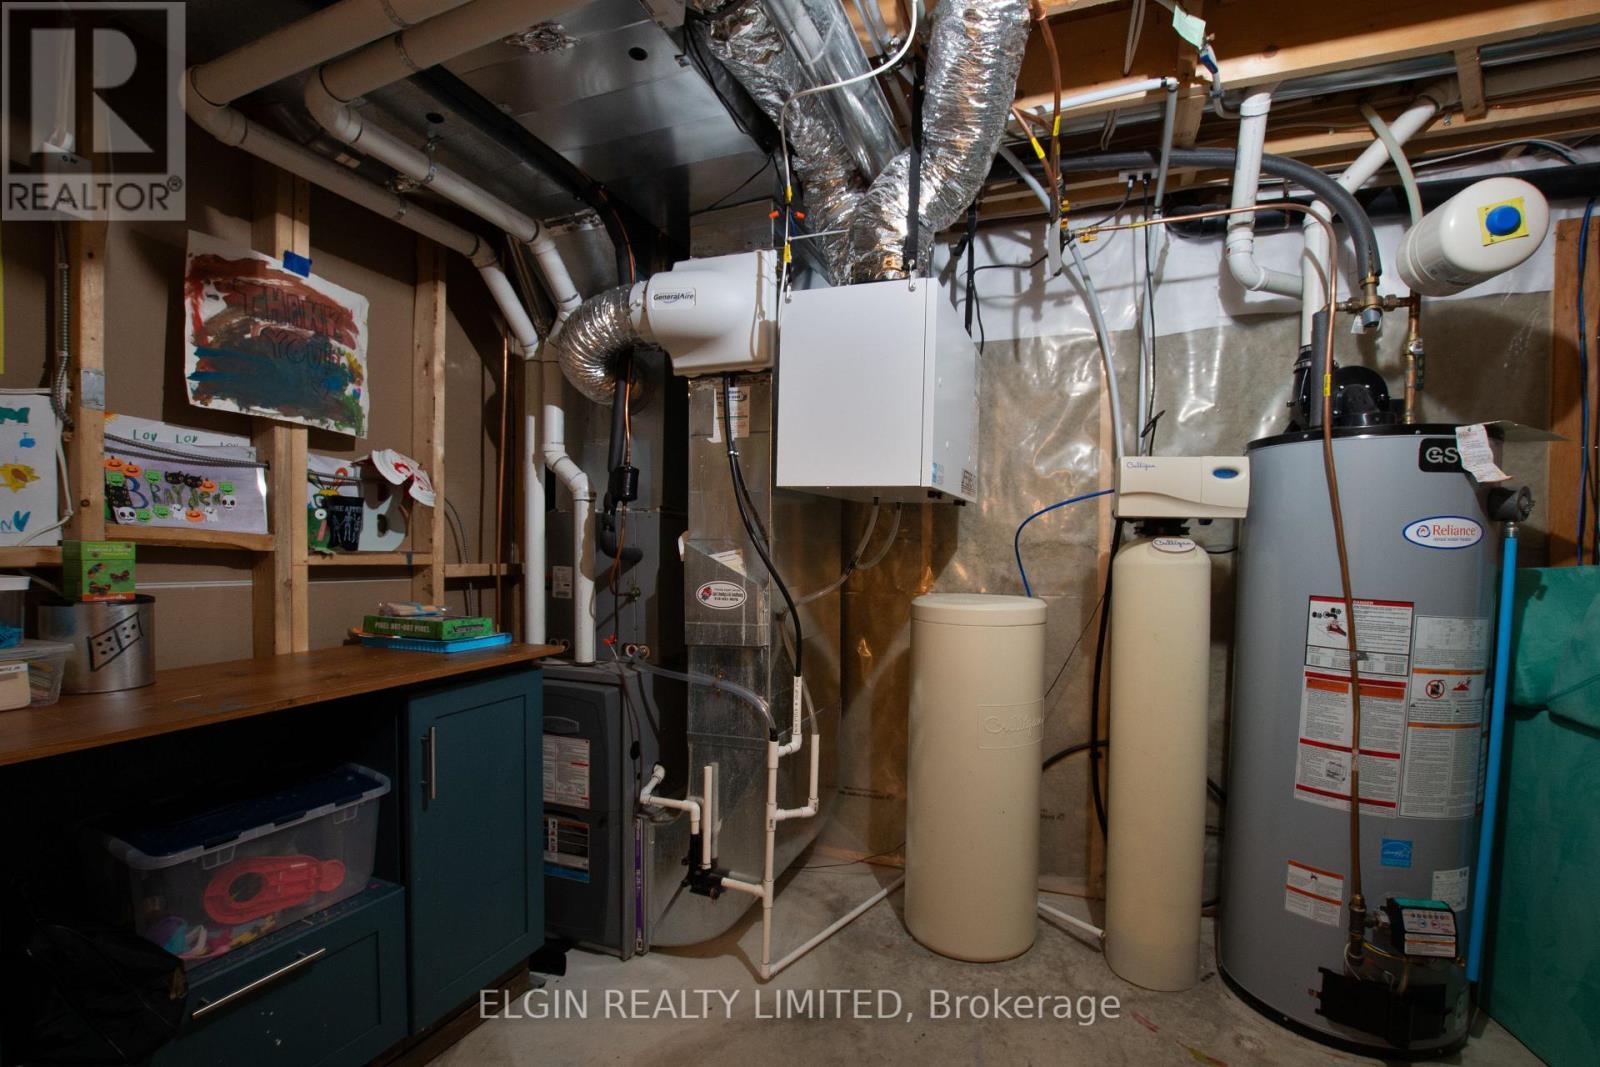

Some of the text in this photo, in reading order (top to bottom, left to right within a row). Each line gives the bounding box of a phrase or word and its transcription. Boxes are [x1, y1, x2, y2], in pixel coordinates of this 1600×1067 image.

[653, 292, 695, 301] GeneralAire
[1126, 462, 1156, 471] Culligan
[1432, 524, 1476, 536] Reliance
[1153, 539, 1194, 548] Culligan
